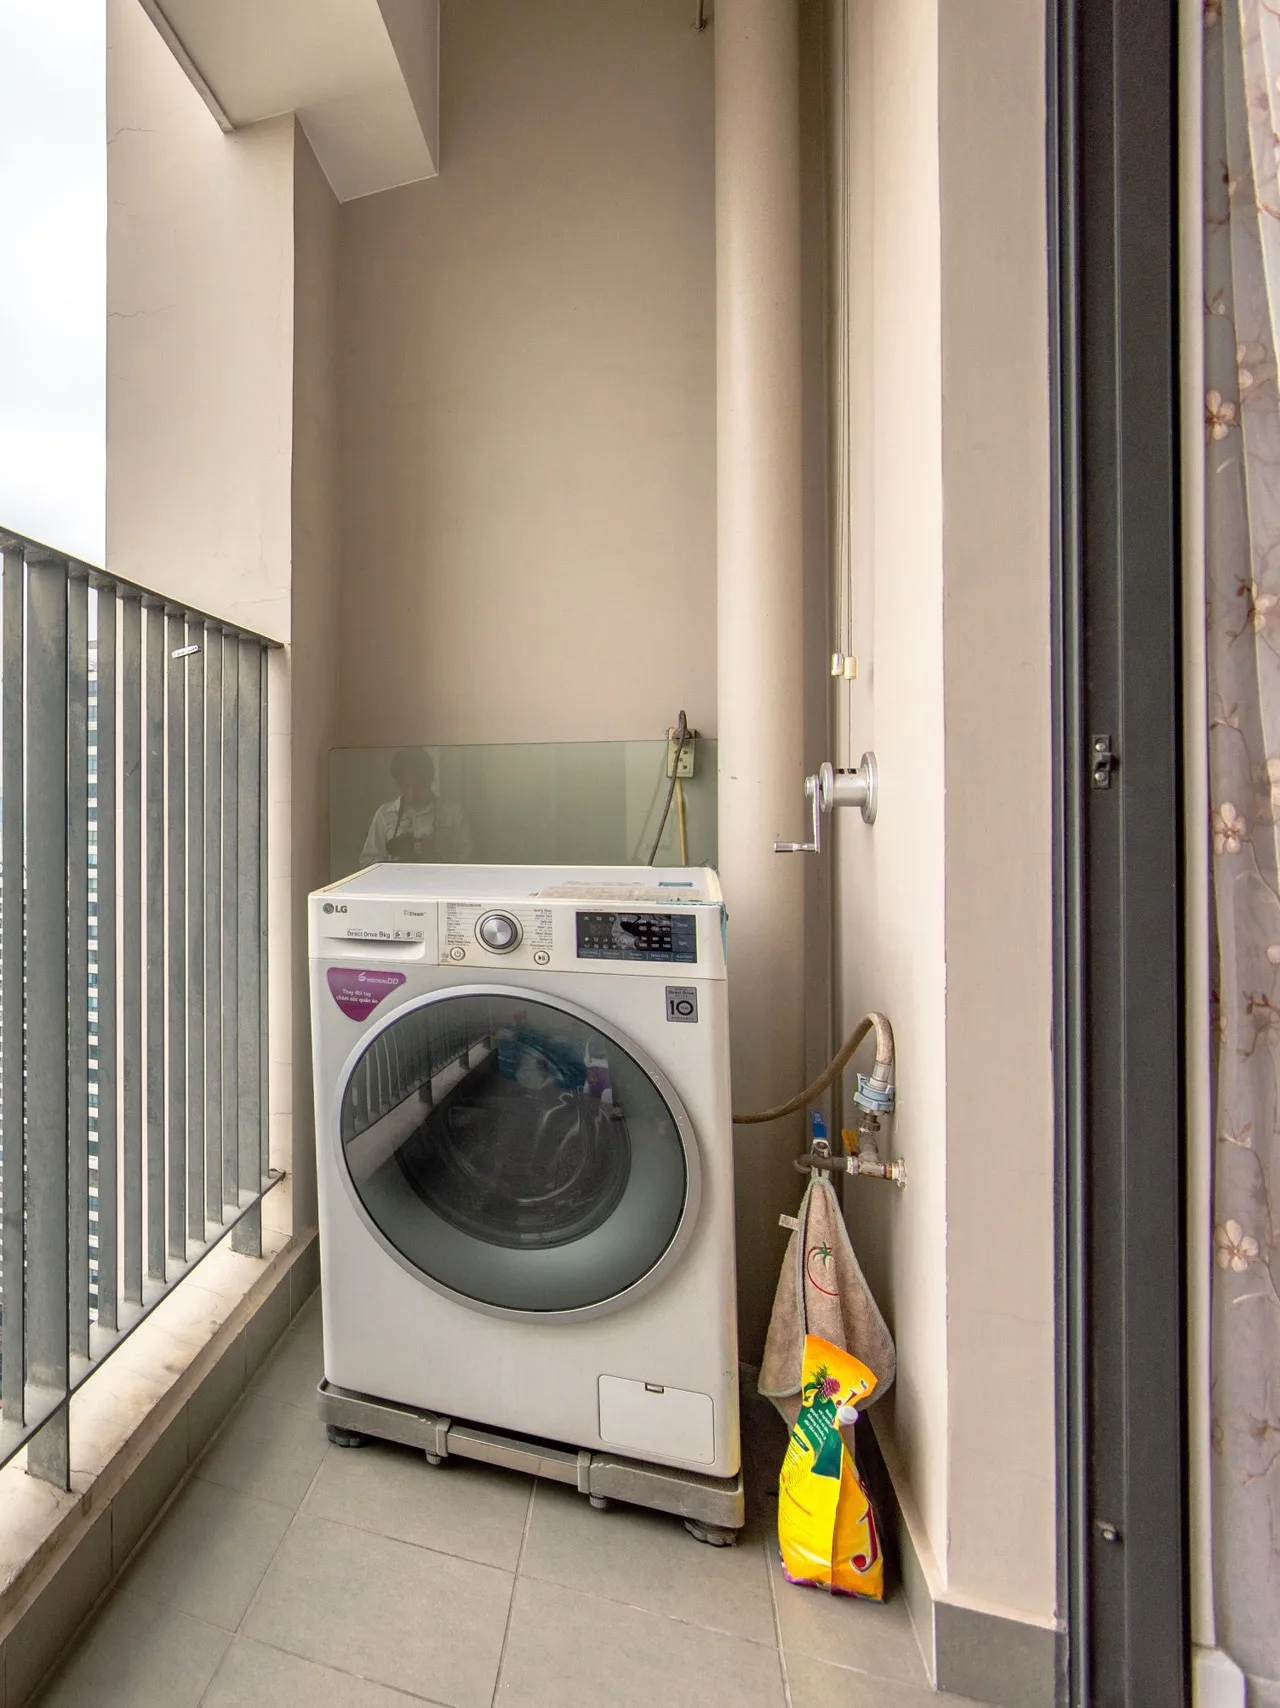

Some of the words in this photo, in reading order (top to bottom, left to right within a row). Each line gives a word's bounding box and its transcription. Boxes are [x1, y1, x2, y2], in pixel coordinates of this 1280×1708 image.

[335, 905, 348, 913] LG
[379, 930, 391, 939] 9kg
[670, 1000, 694, 1016] 10
